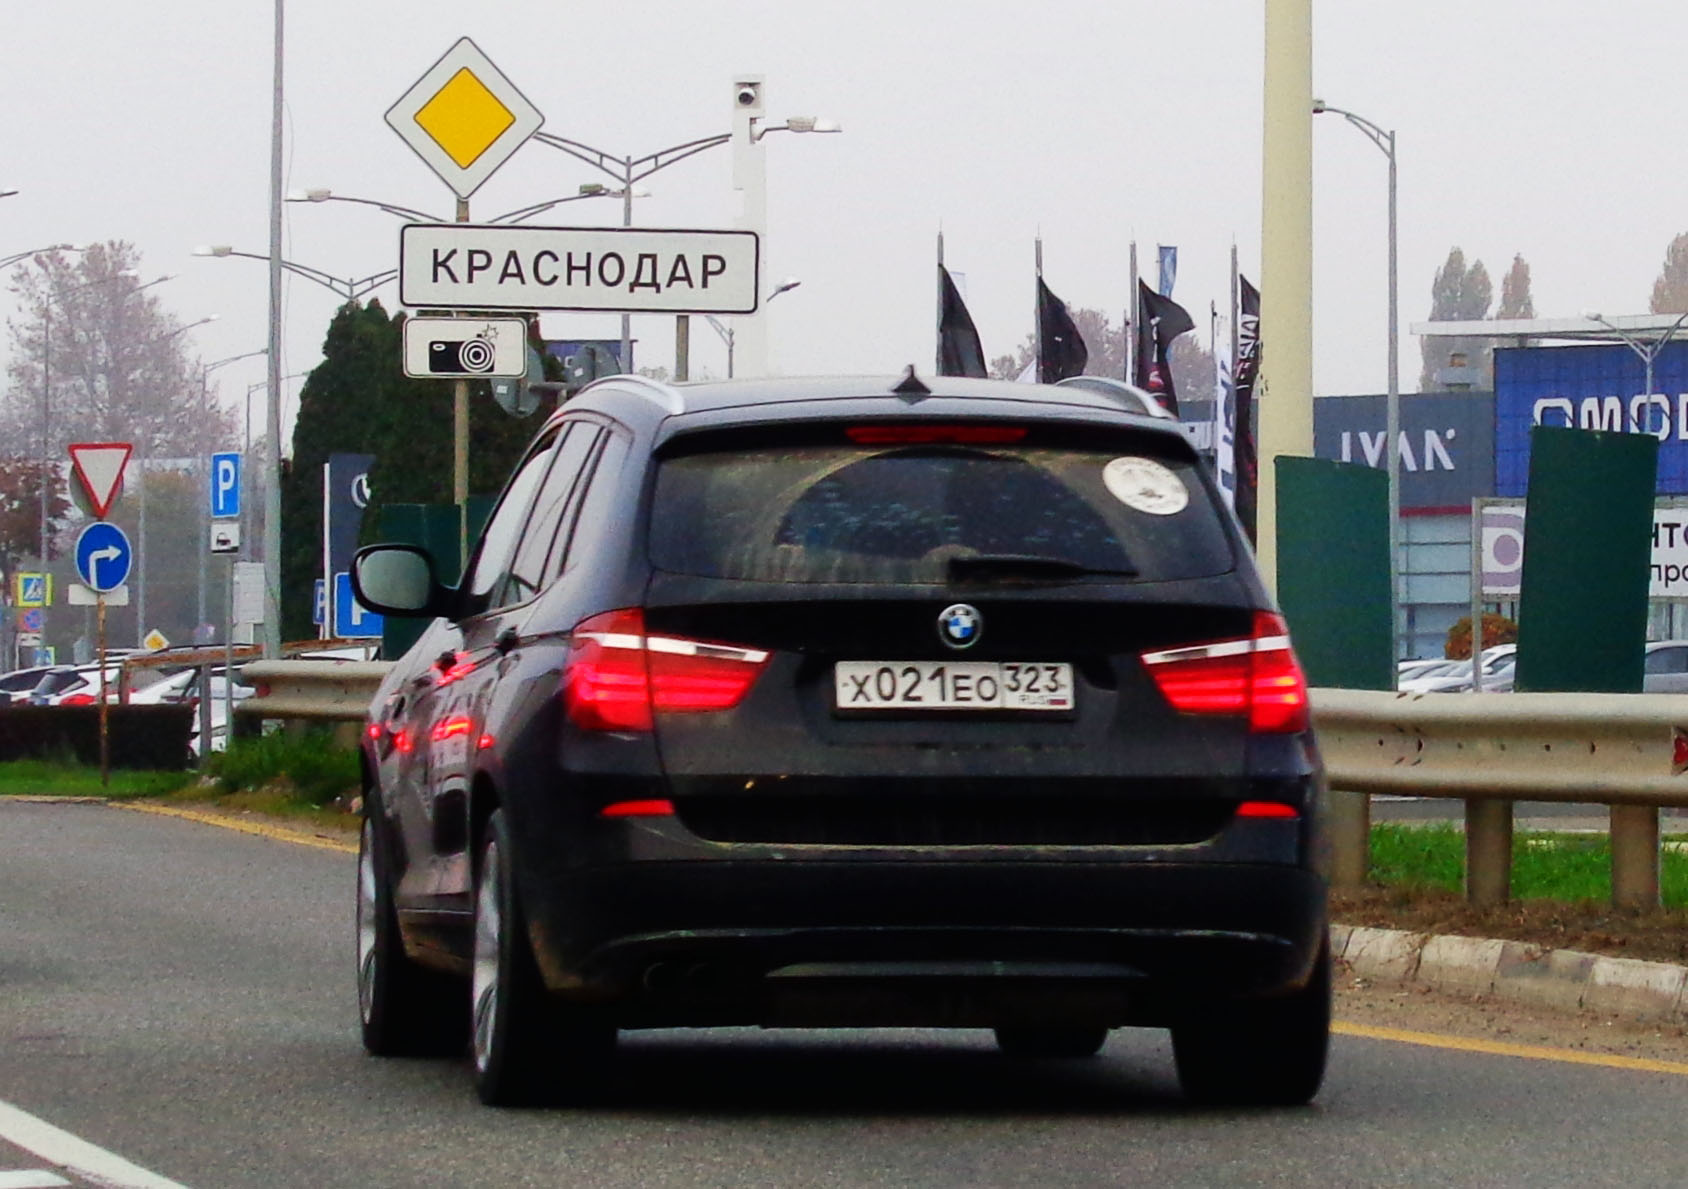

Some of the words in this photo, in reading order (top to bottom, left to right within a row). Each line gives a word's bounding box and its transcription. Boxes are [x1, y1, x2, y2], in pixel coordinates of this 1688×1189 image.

[431, 248, 727, 294] КРАСНОДАР
[1533, 393, 1688, 441] OMO
[1004, 665, 1062, 693] 323
